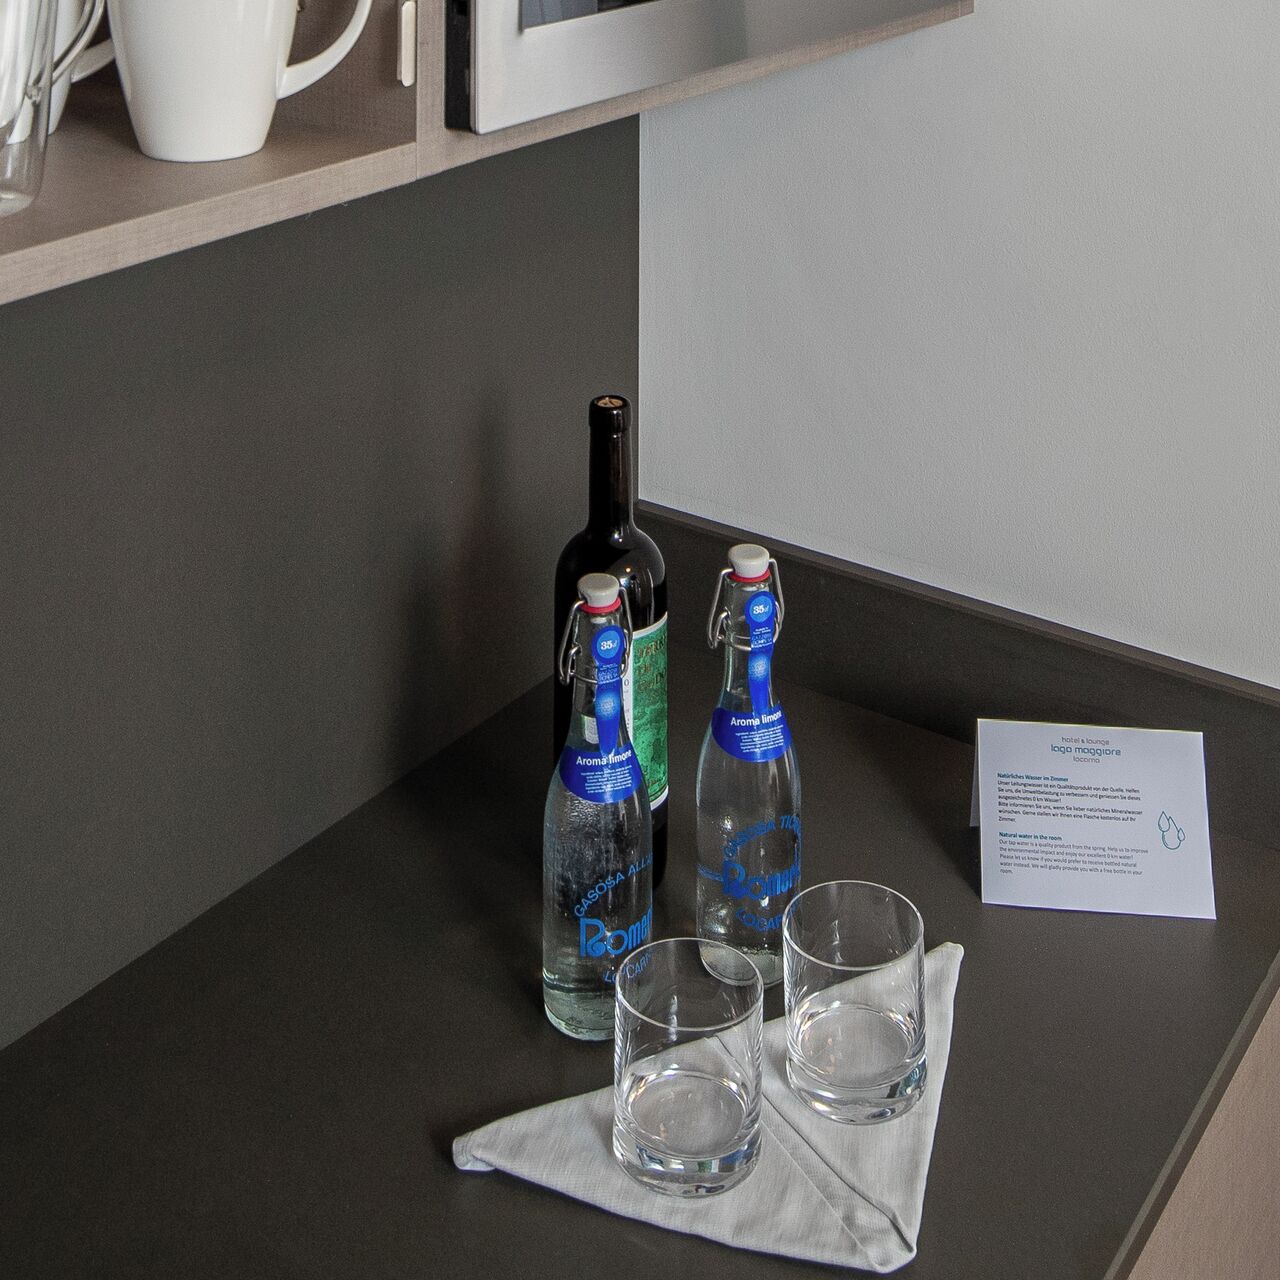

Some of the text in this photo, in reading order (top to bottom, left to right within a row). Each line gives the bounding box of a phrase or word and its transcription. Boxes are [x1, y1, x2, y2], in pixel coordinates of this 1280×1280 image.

[730, 717, 760, 726] Aroma
[1086, 738, 1109, 746] lounge
[1051, 744, 1121, 757] lago maggiore
[576, 756, 607, 766] Aroma
[574, 872, 625, 917] GASOSA
